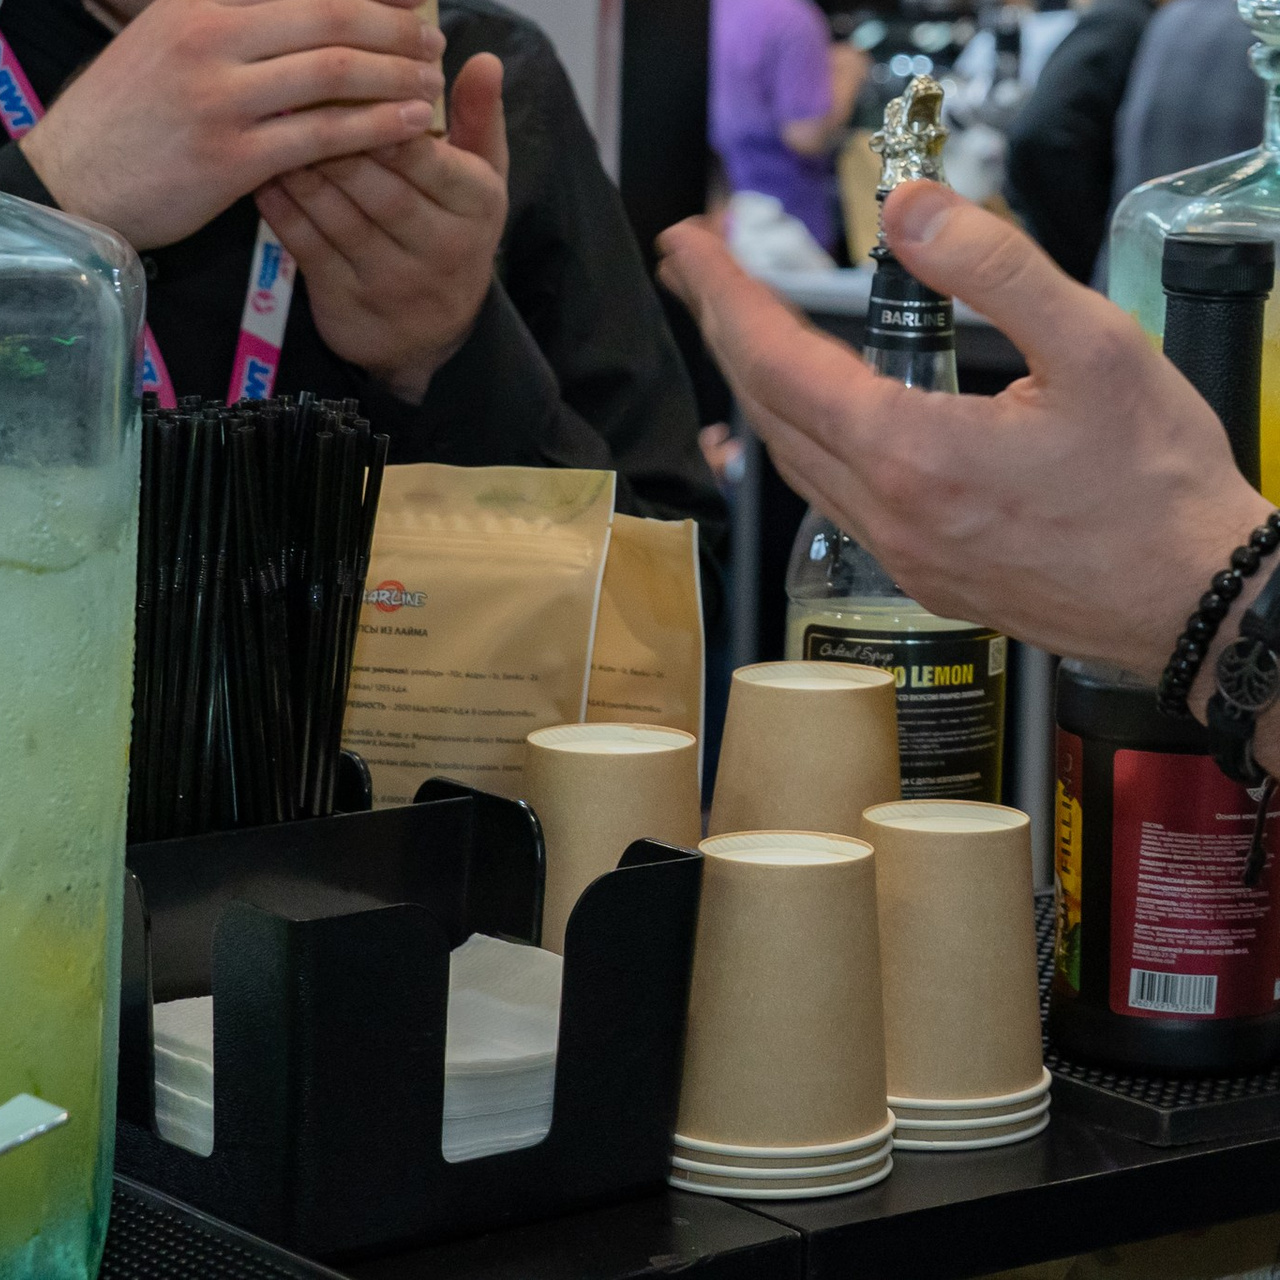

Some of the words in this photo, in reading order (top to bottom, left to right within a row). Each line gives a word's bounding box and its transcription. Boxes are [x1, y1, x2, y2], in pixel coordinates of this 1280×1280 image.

[881, 309, 946, 328] BARLINE
[381, 626, 393, 636] ИЗ
[394, 626, 428, 638] ЛАЙМА
[820, 642, 861, 660] Cocktail
[860, 646, 894, 666] Syrup
[911, 663, 974, 688] LEMON
